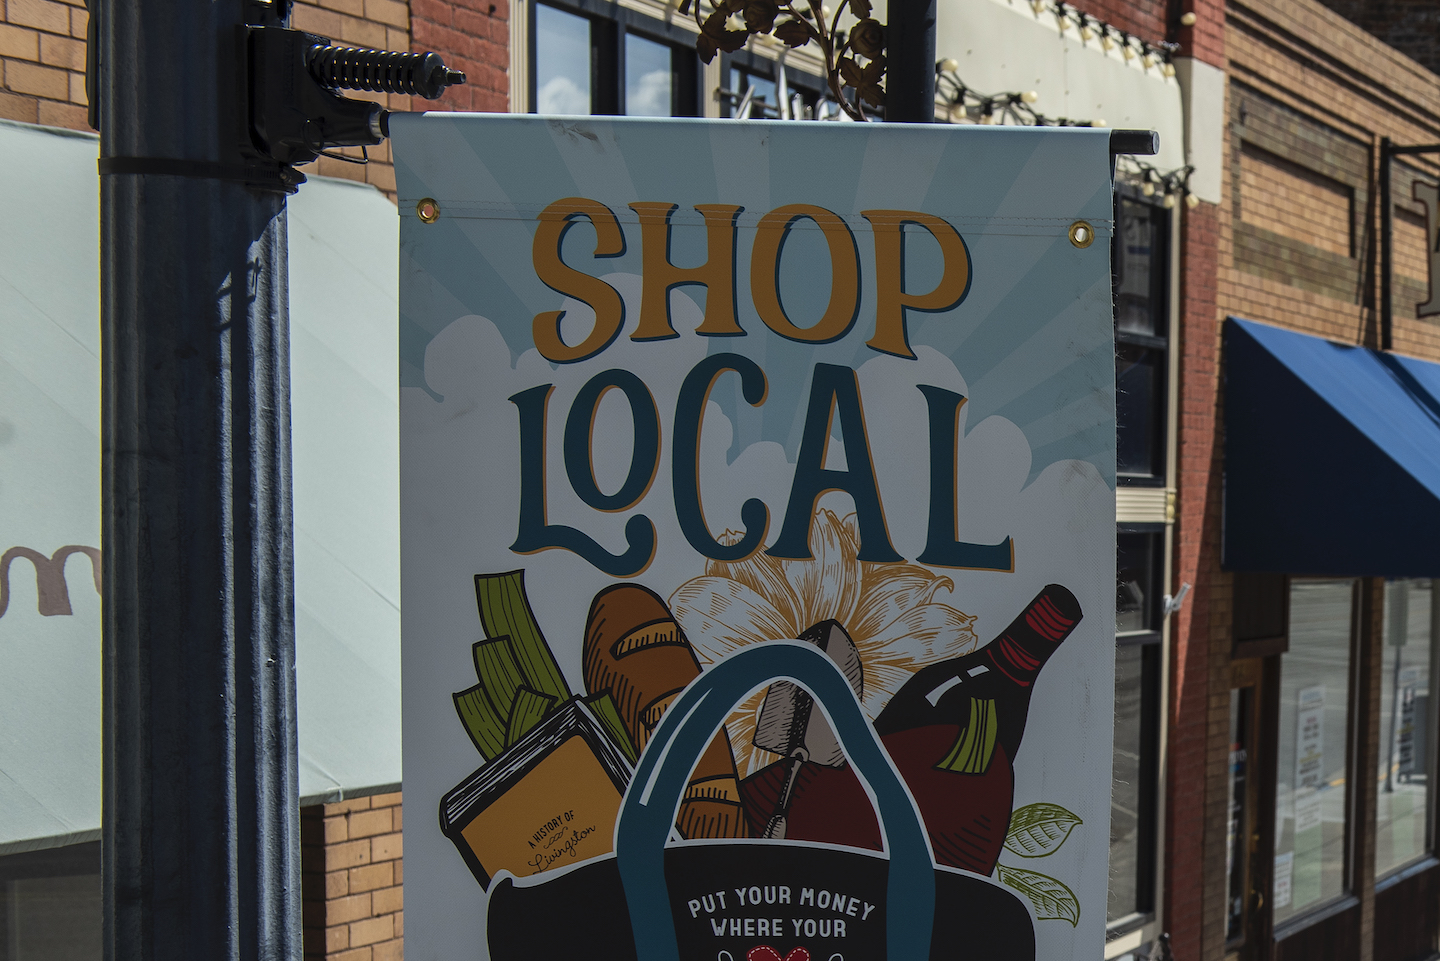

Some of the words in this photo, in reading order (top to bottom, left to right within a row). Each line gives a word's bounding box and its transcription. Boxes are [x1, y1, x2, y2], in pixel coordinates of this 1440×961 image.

[531, 196, 973, 364] SHOP
[507, 352, 1015, 578] LOCAL
[527, 839, 536, 850] A
[532, 814, 564, 844] HISTORY
[564, 809, 575, 822] OF
[527, 824, 597, 875] Livingston
[687, 890, 727, 919] PUT
[734, 885, 792, 907] YOUR
[799, 887, 876, 921] MONEY
[710, 918, 784, 937] WHERE
[791, 918, 847, 938] YOUR
